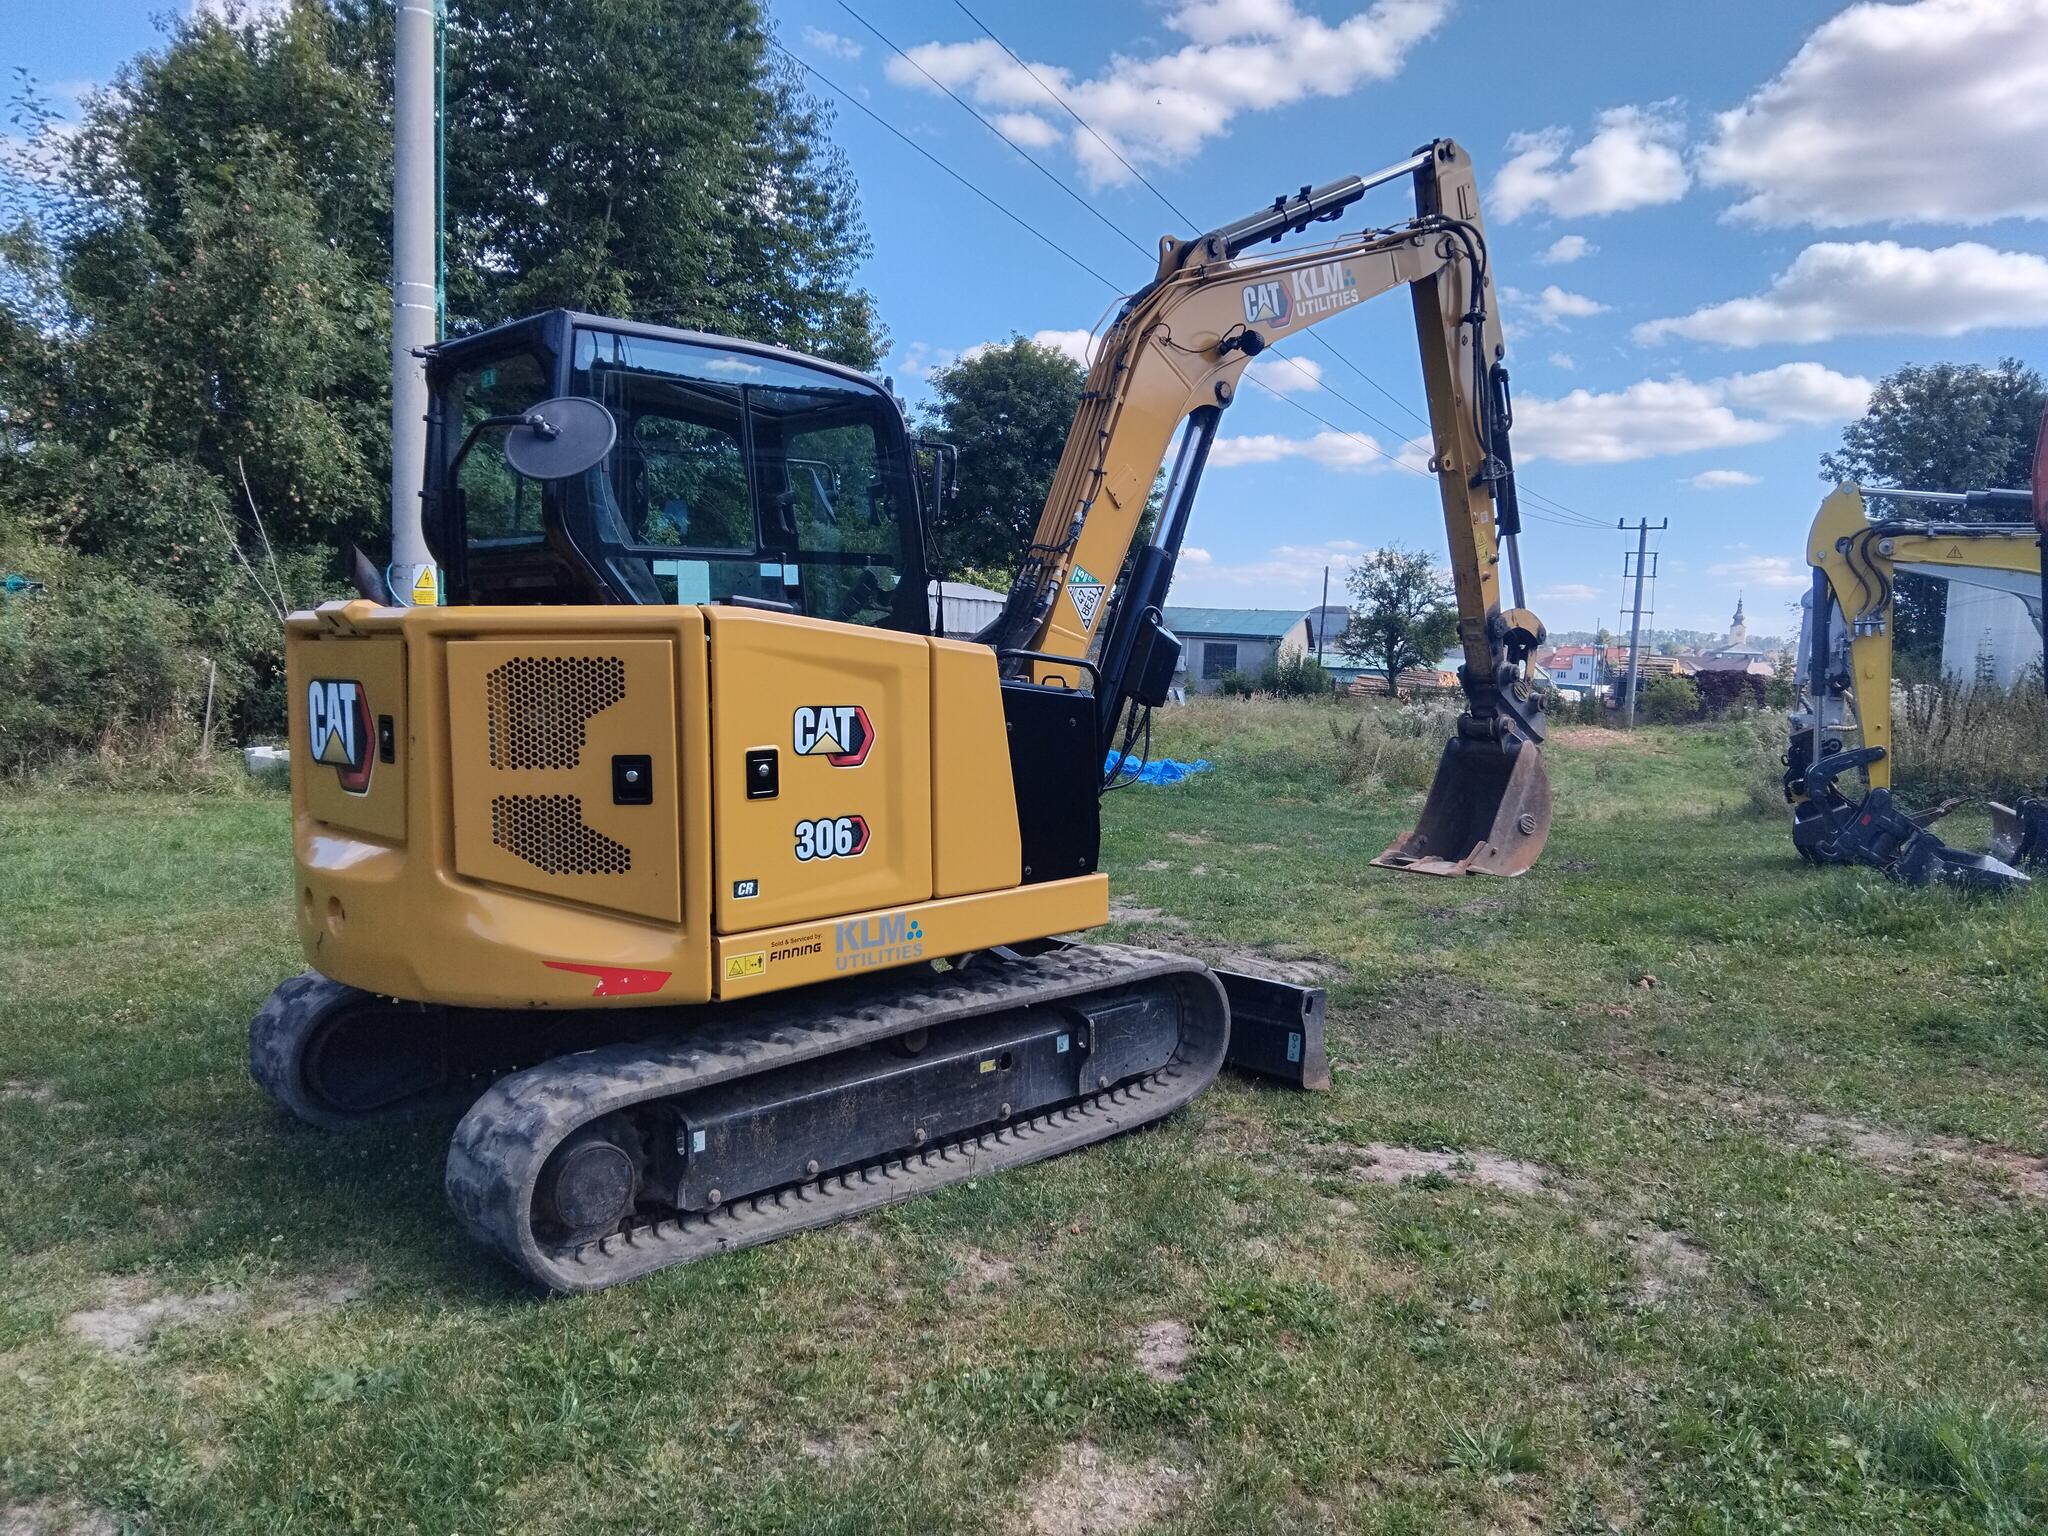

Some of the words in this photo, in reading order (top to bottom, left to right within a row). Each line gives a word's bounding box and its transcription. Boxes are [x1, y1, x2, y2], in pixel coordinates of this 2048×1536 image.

[1291, 261, 1345, 301] KLM
[1243, 281, 1280, 323] CAT
[1296, 288, 1360, 317] UTILITIES
[309, 680, 356, 765] CAT
[794, 706, 855, 754] CAT
[795, 817, 852, 860] 306
[737, 881, 754, 896] CR
[769, 942, 822, 962] FINNING
[770, 940, 784, 948] Sold
[790, 933, 814, 944] Serviced
[835, 914, 906, 953] KLM
[836, 942, 923, 971] UTILITIES
